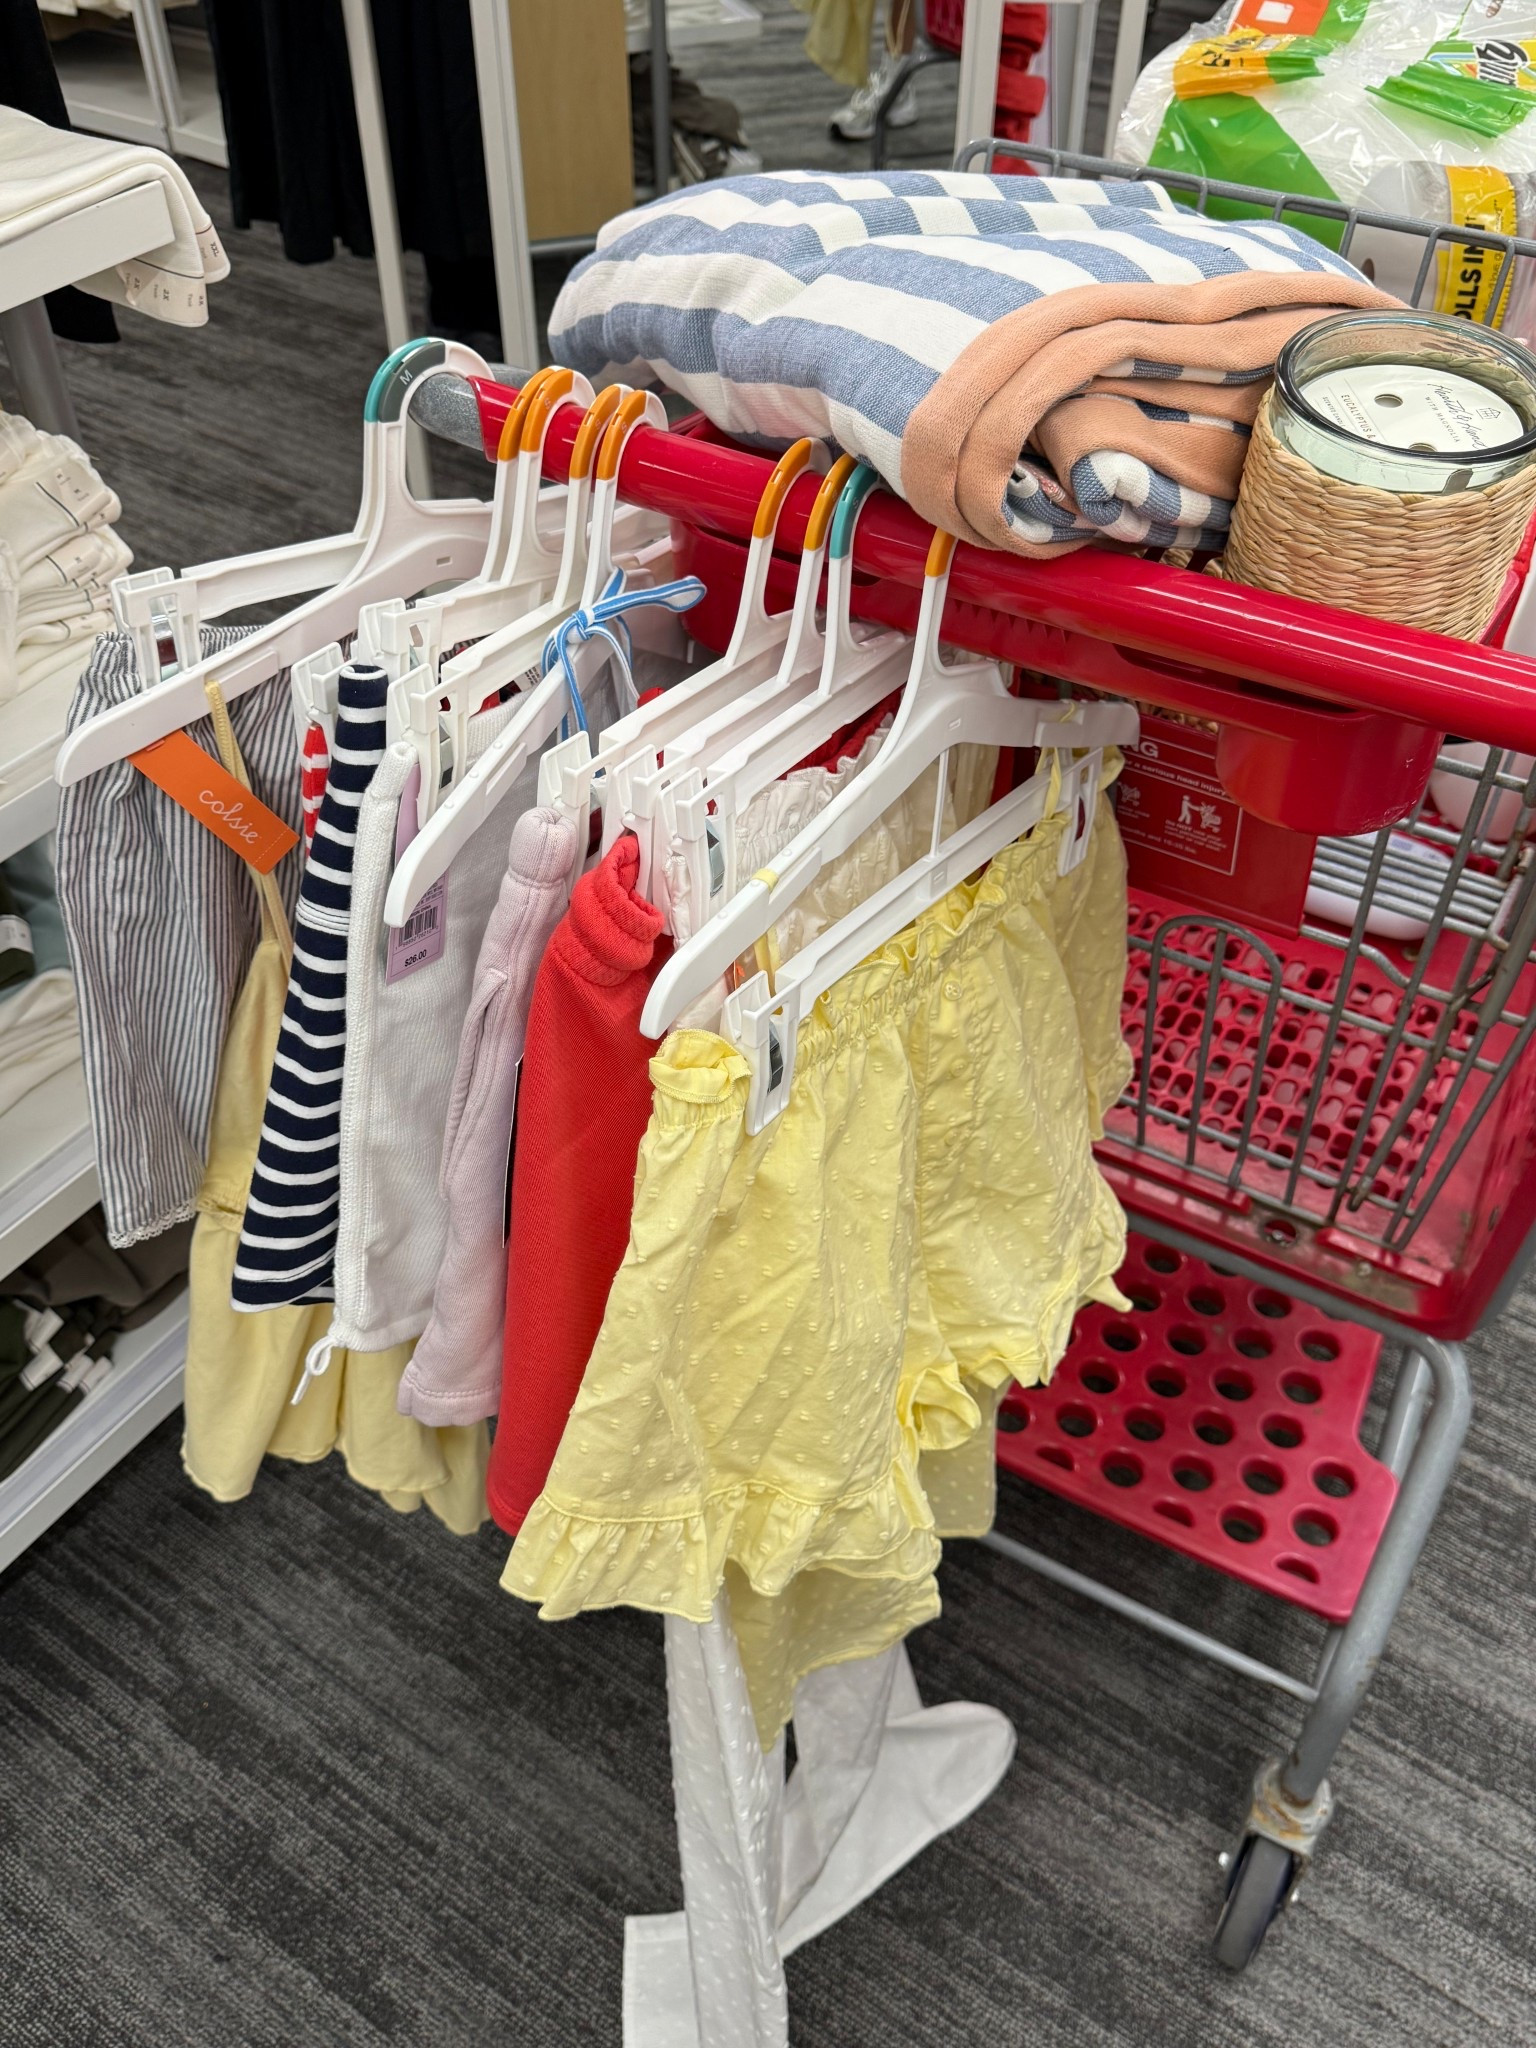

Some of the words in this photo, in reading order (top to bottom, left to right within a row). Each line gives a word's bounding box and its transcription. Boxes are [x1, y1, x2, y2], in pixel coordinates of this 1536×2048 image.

[1454, 268, 1482, 320] OLLS
[399, 370, 413, 386] M
[1341, 393, 1372, 433] EUCALYPTUS
[1425, 396, 1439, 411] WITH
[1436, 411, 1460, 443] MAGNOLIA
[1456, 421, 1489, 449] Hand
[199, 789, 259, 844] colsie
[405, 949, 427, 967] $26.00
